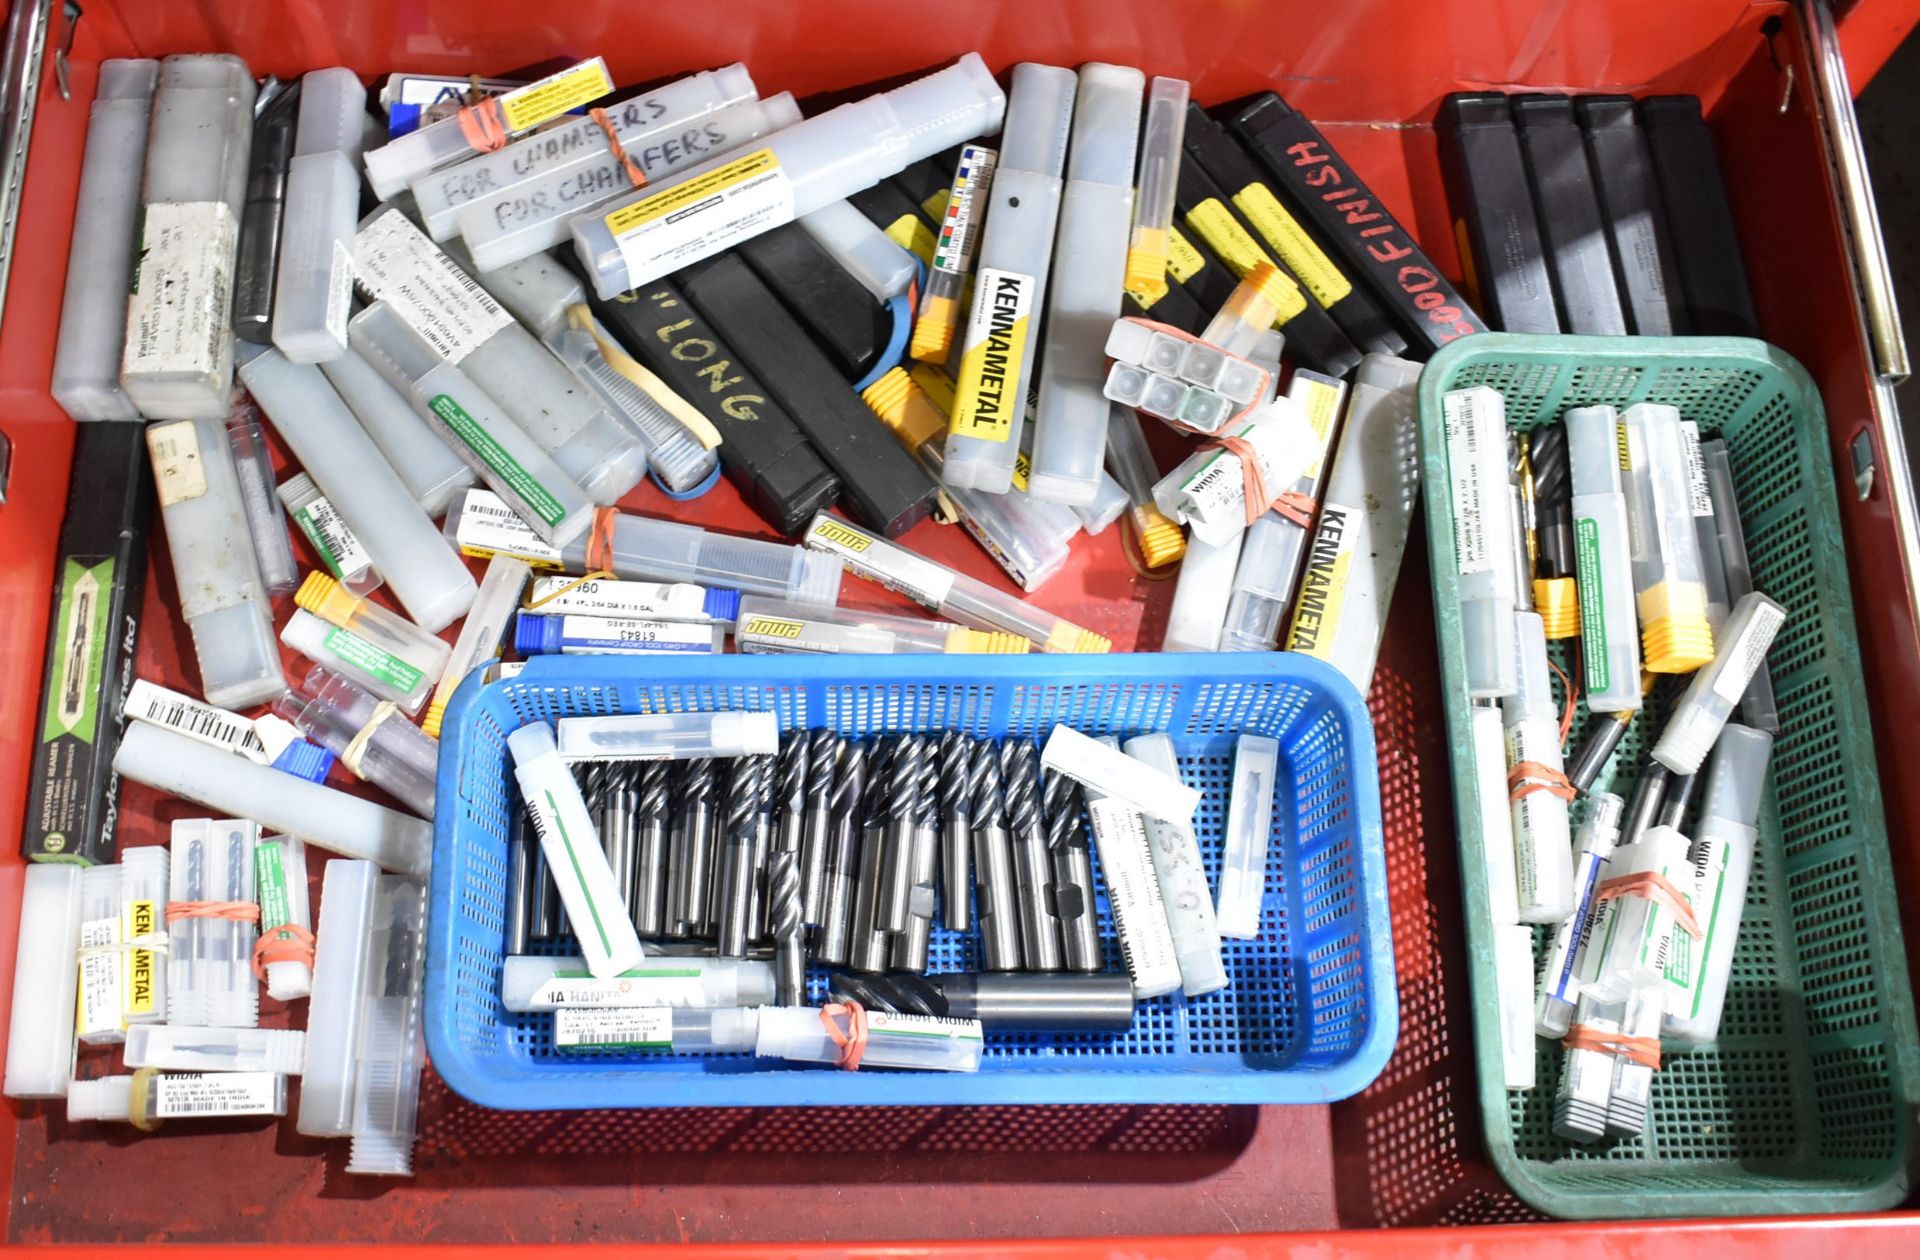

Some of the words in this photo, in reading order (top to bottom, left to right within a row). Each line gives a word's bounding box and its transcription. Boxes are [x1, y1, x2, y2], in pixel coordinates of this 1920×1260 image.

[438, 160, 500, 209] FOR
[1286, 139, 1411, 265] FINISH
[491, 184, 556, 232] FOR
[973, 276, 1021, 430] KENNAMETAL
[658, 320, 763, 426] LONG
[1191, 466, 1225, 497] WIDIA
[1290, 508, 1347, 654] KENNAMETA
[121, 615, 137, 653] ltd
[587, 639, 619, 647] Company
[620, 630, 656, 641] 61843
[111, 657, 133, 730] Jones
[47, 741, 59, 777] REAMER
[40, 779, 55, 831] ADJUSTABLE
[526, 800, 548, 839] WIDIA
[1694, 840, 1712, 879] WIDIA
[1569, 933, 1579, 950] TOOL
[1574, 910, 1585, 932] GROUP
[1655, 935, 1670, 970] WIDIA
[885, 1011, 931, 1023] HANITA
[936, 1015, 974, 1026] WIDIA
